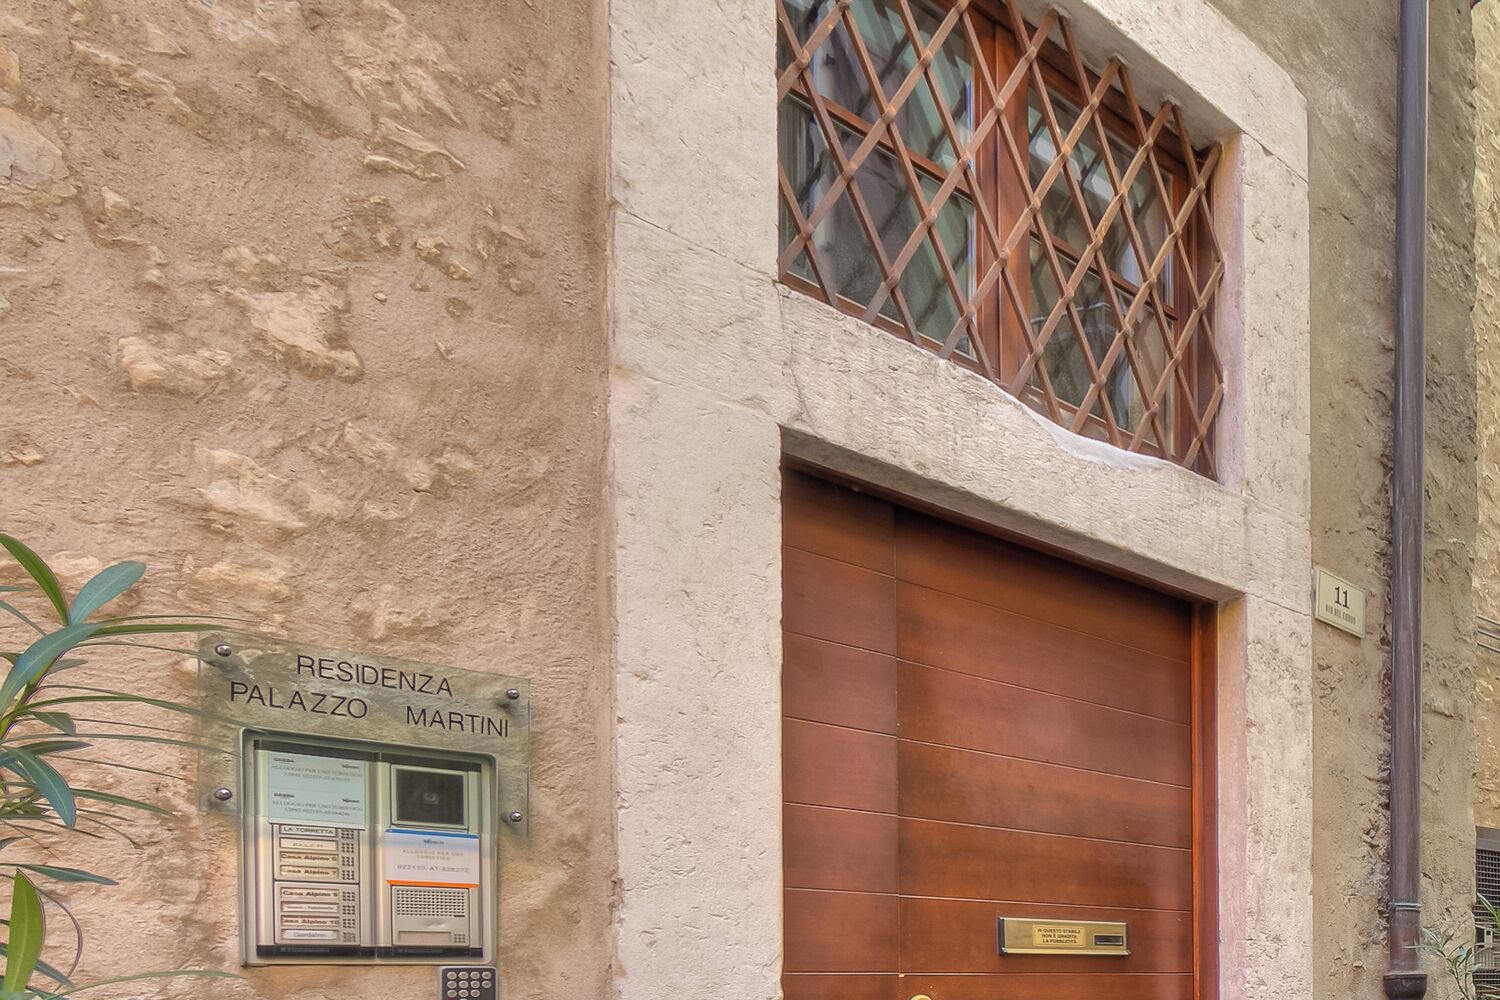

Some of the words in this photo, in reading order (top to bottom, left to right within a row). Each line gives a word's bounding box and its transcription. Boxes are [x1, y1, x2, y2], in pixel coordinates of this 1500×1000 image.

[1335, 586, 1350, 609] 11
[296, 655, 454, 698] RESIDENZA
[229, 681, 369, 719] PALAZZO
[406, 705, 509, 738] MARTINI
